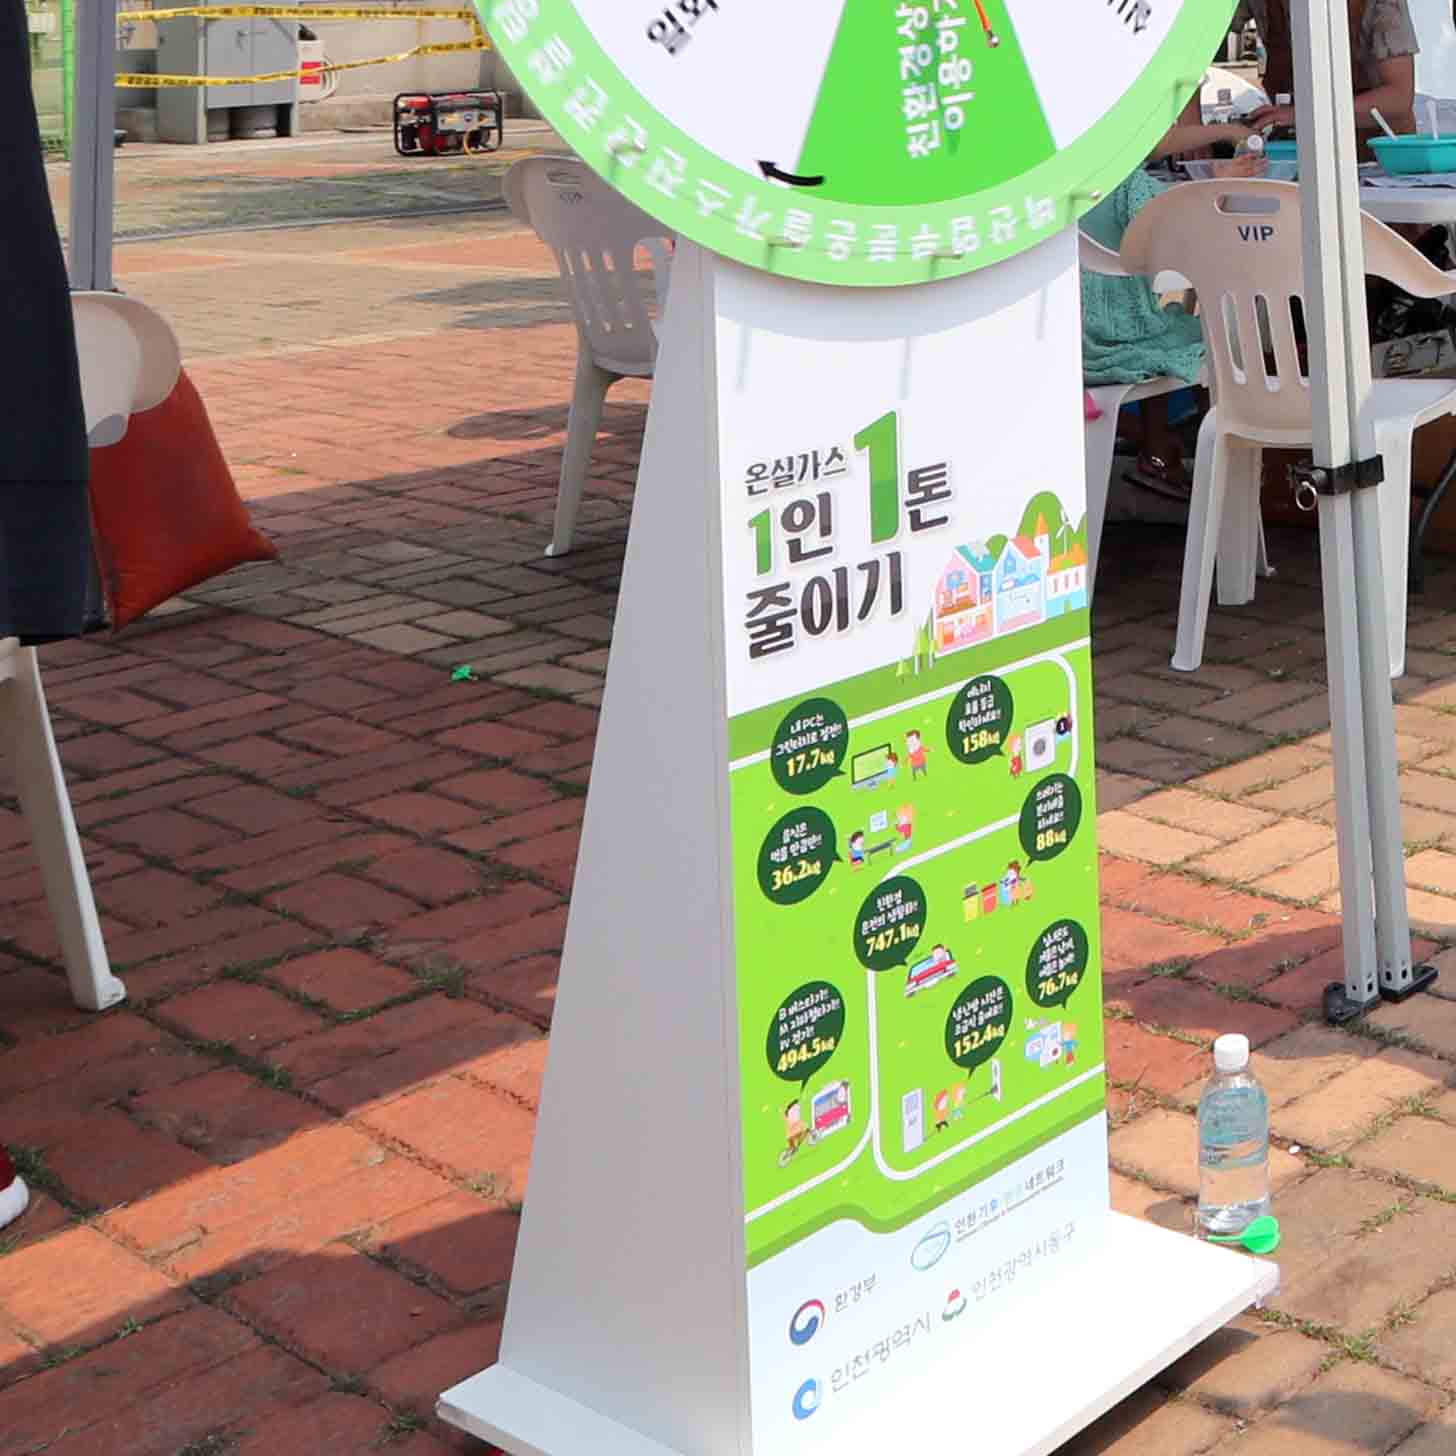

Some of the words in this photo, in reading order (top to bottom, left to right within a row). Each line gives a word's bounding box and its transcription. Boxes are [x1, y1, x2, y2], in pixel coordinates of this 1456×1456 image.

[1238, 225, 1274, 242] VIP
[744, 446, 847, 496] 온실가스
[748, 491, 834, 576] 1인
[744, 551, 904, 660] 줄이기
[962, 730, 1000, 754] 158kg
[787, 748, 835, 777] 17.7kg
[1036, 829, 1067, 852] 88kg
[771, 859, 821, 891] 36.2kg
[866, 923, 920, 957] 747.1kg
[834, 1272, 880, 1313] 환경부
[831, 1311, 931, 1393] 인천광역시
